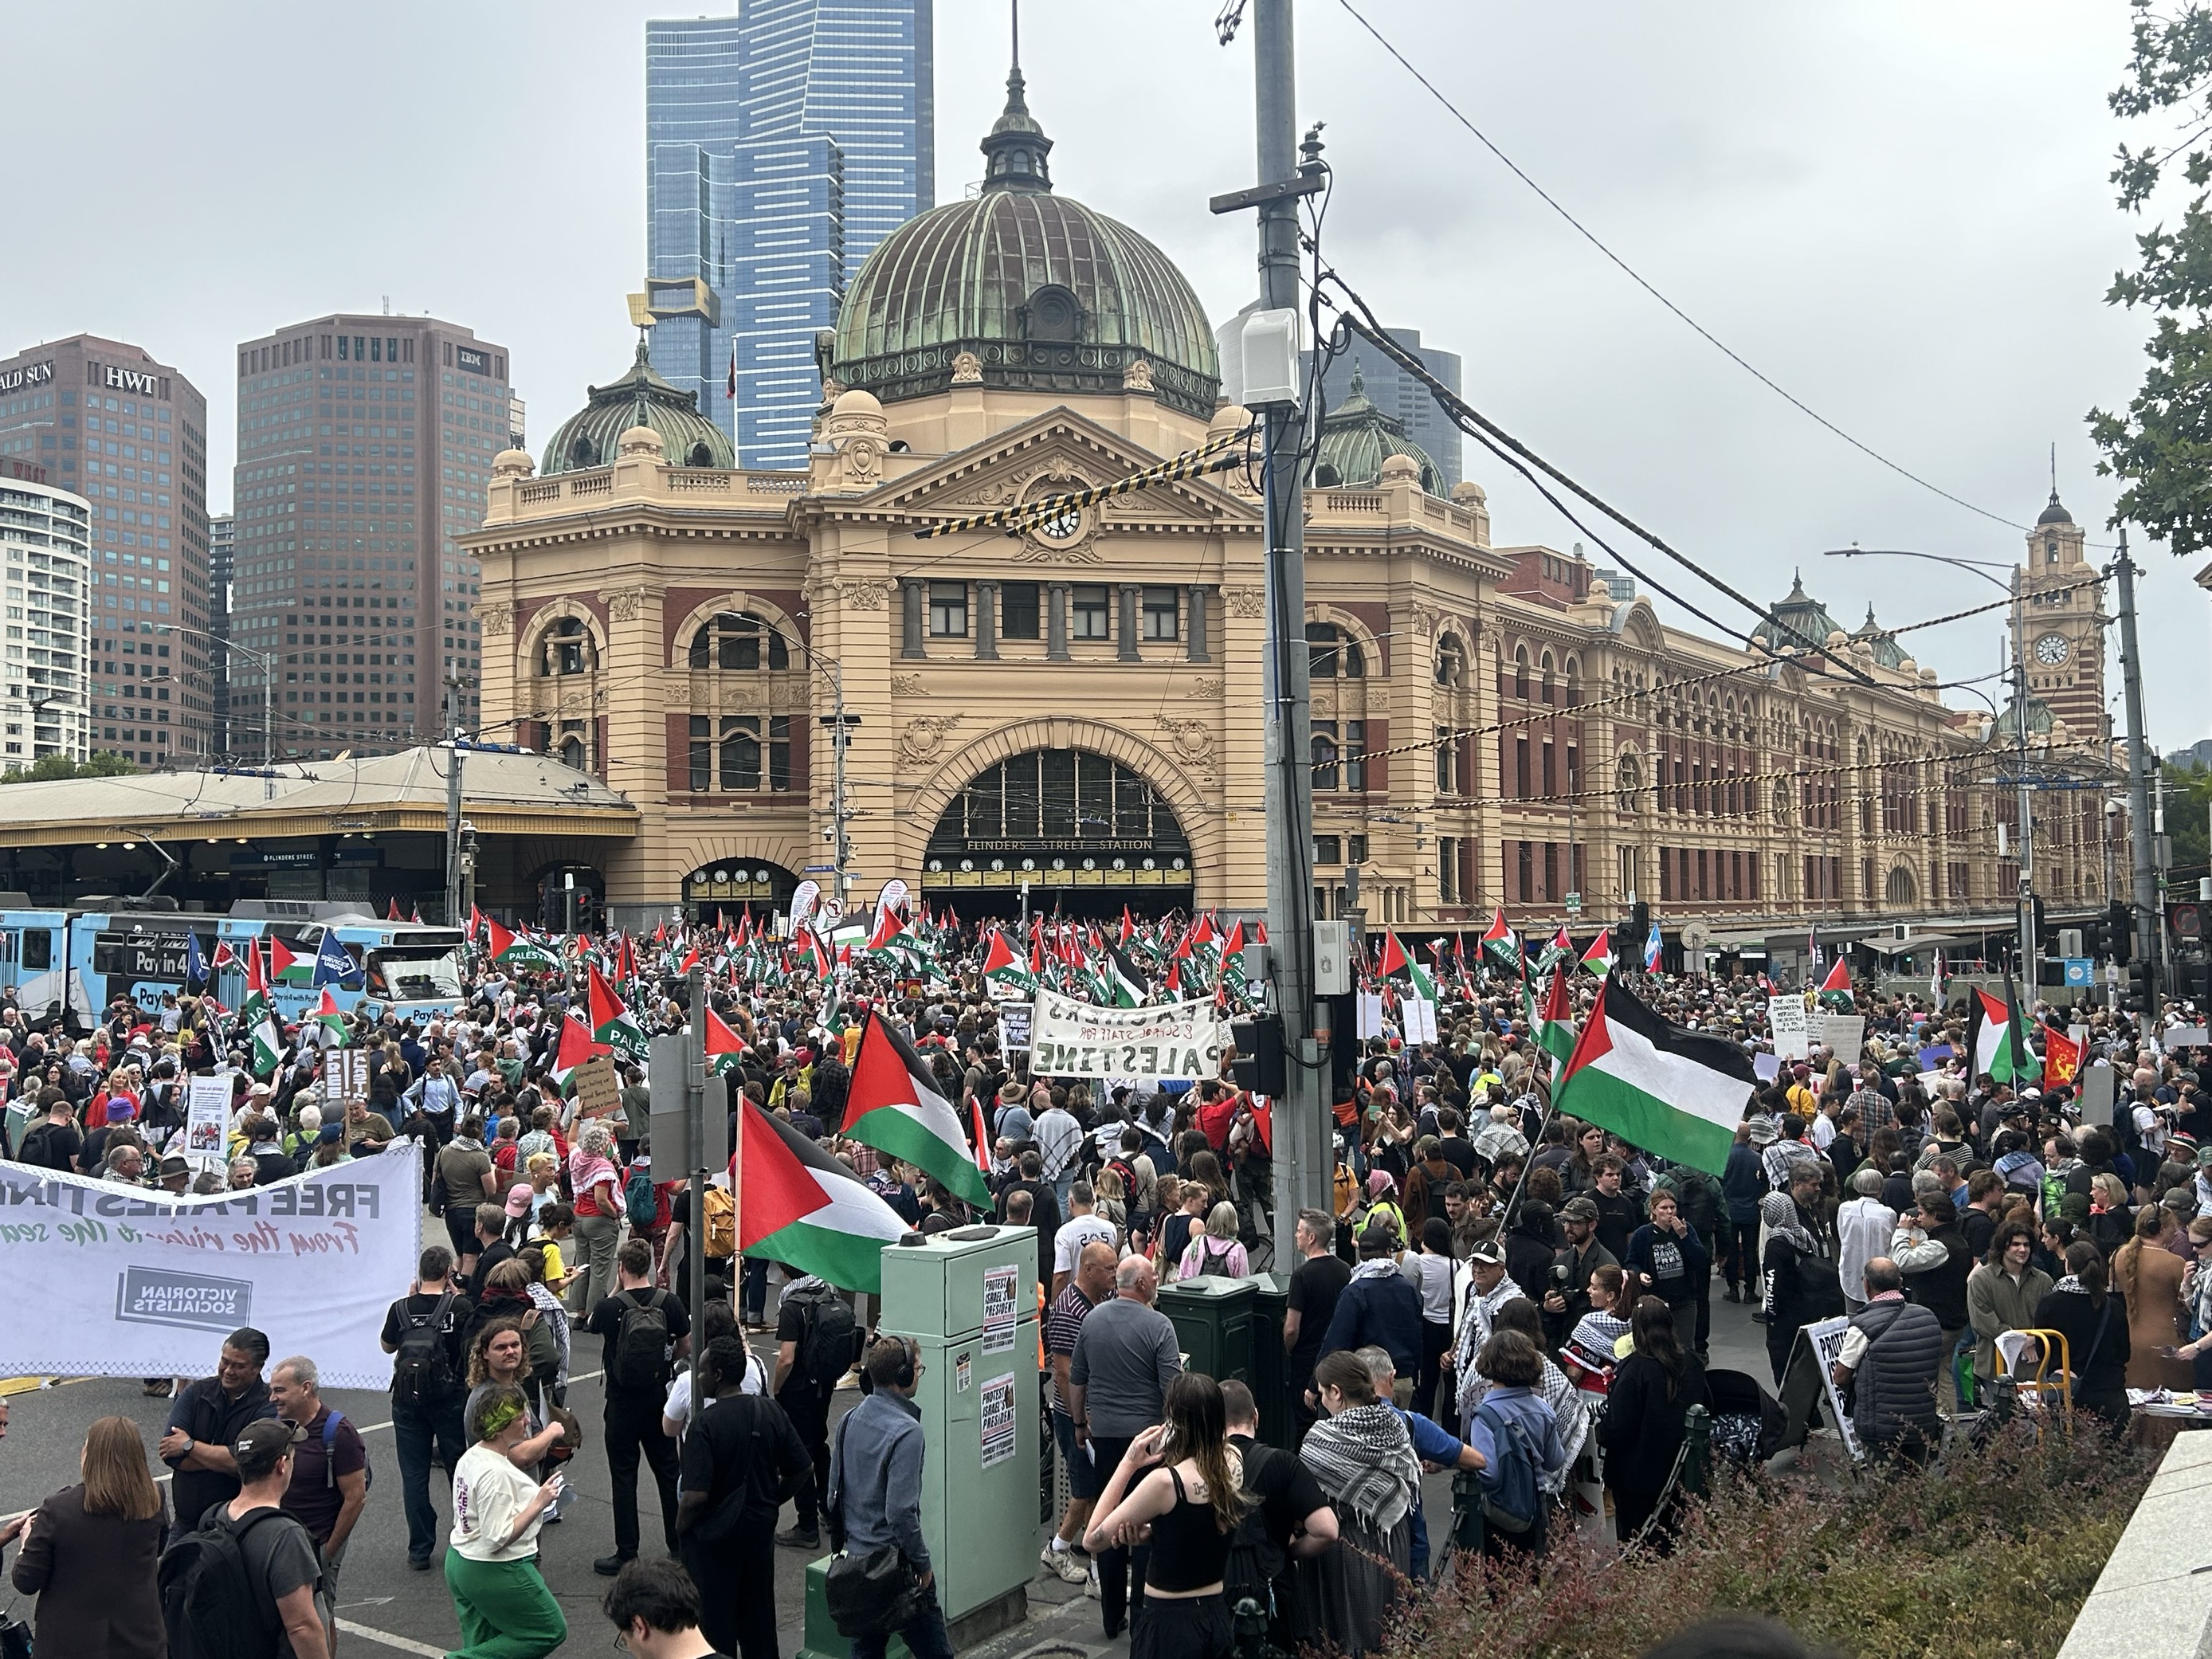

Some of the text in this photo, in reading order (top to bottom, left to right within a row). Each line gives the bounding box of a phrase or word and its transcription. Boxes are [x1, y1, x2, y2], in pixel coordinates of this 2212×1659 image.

[461, 351, 480, 366] IBM
[27, 363, 53, 383] SUN
[106, 367, 157, 394] HWT
[13, 462, 46, 484] WEST
[967, 840, 1152, 850] FLINDERS STREET STATION
[136, 951, 187, 975] Pay in 4
[326, 1050, 342, 1099] FREE
[986, 1277, 1007, 1292] PROTEST
[985, 1300, 1015, 1318] PRESIDENT
[982, 1386, 1005, 1405] PROTEST
[982, 1399, 1006, 1418] ISRAEL'S
[982, 1408, 1014, 1430] PRESIDENT
